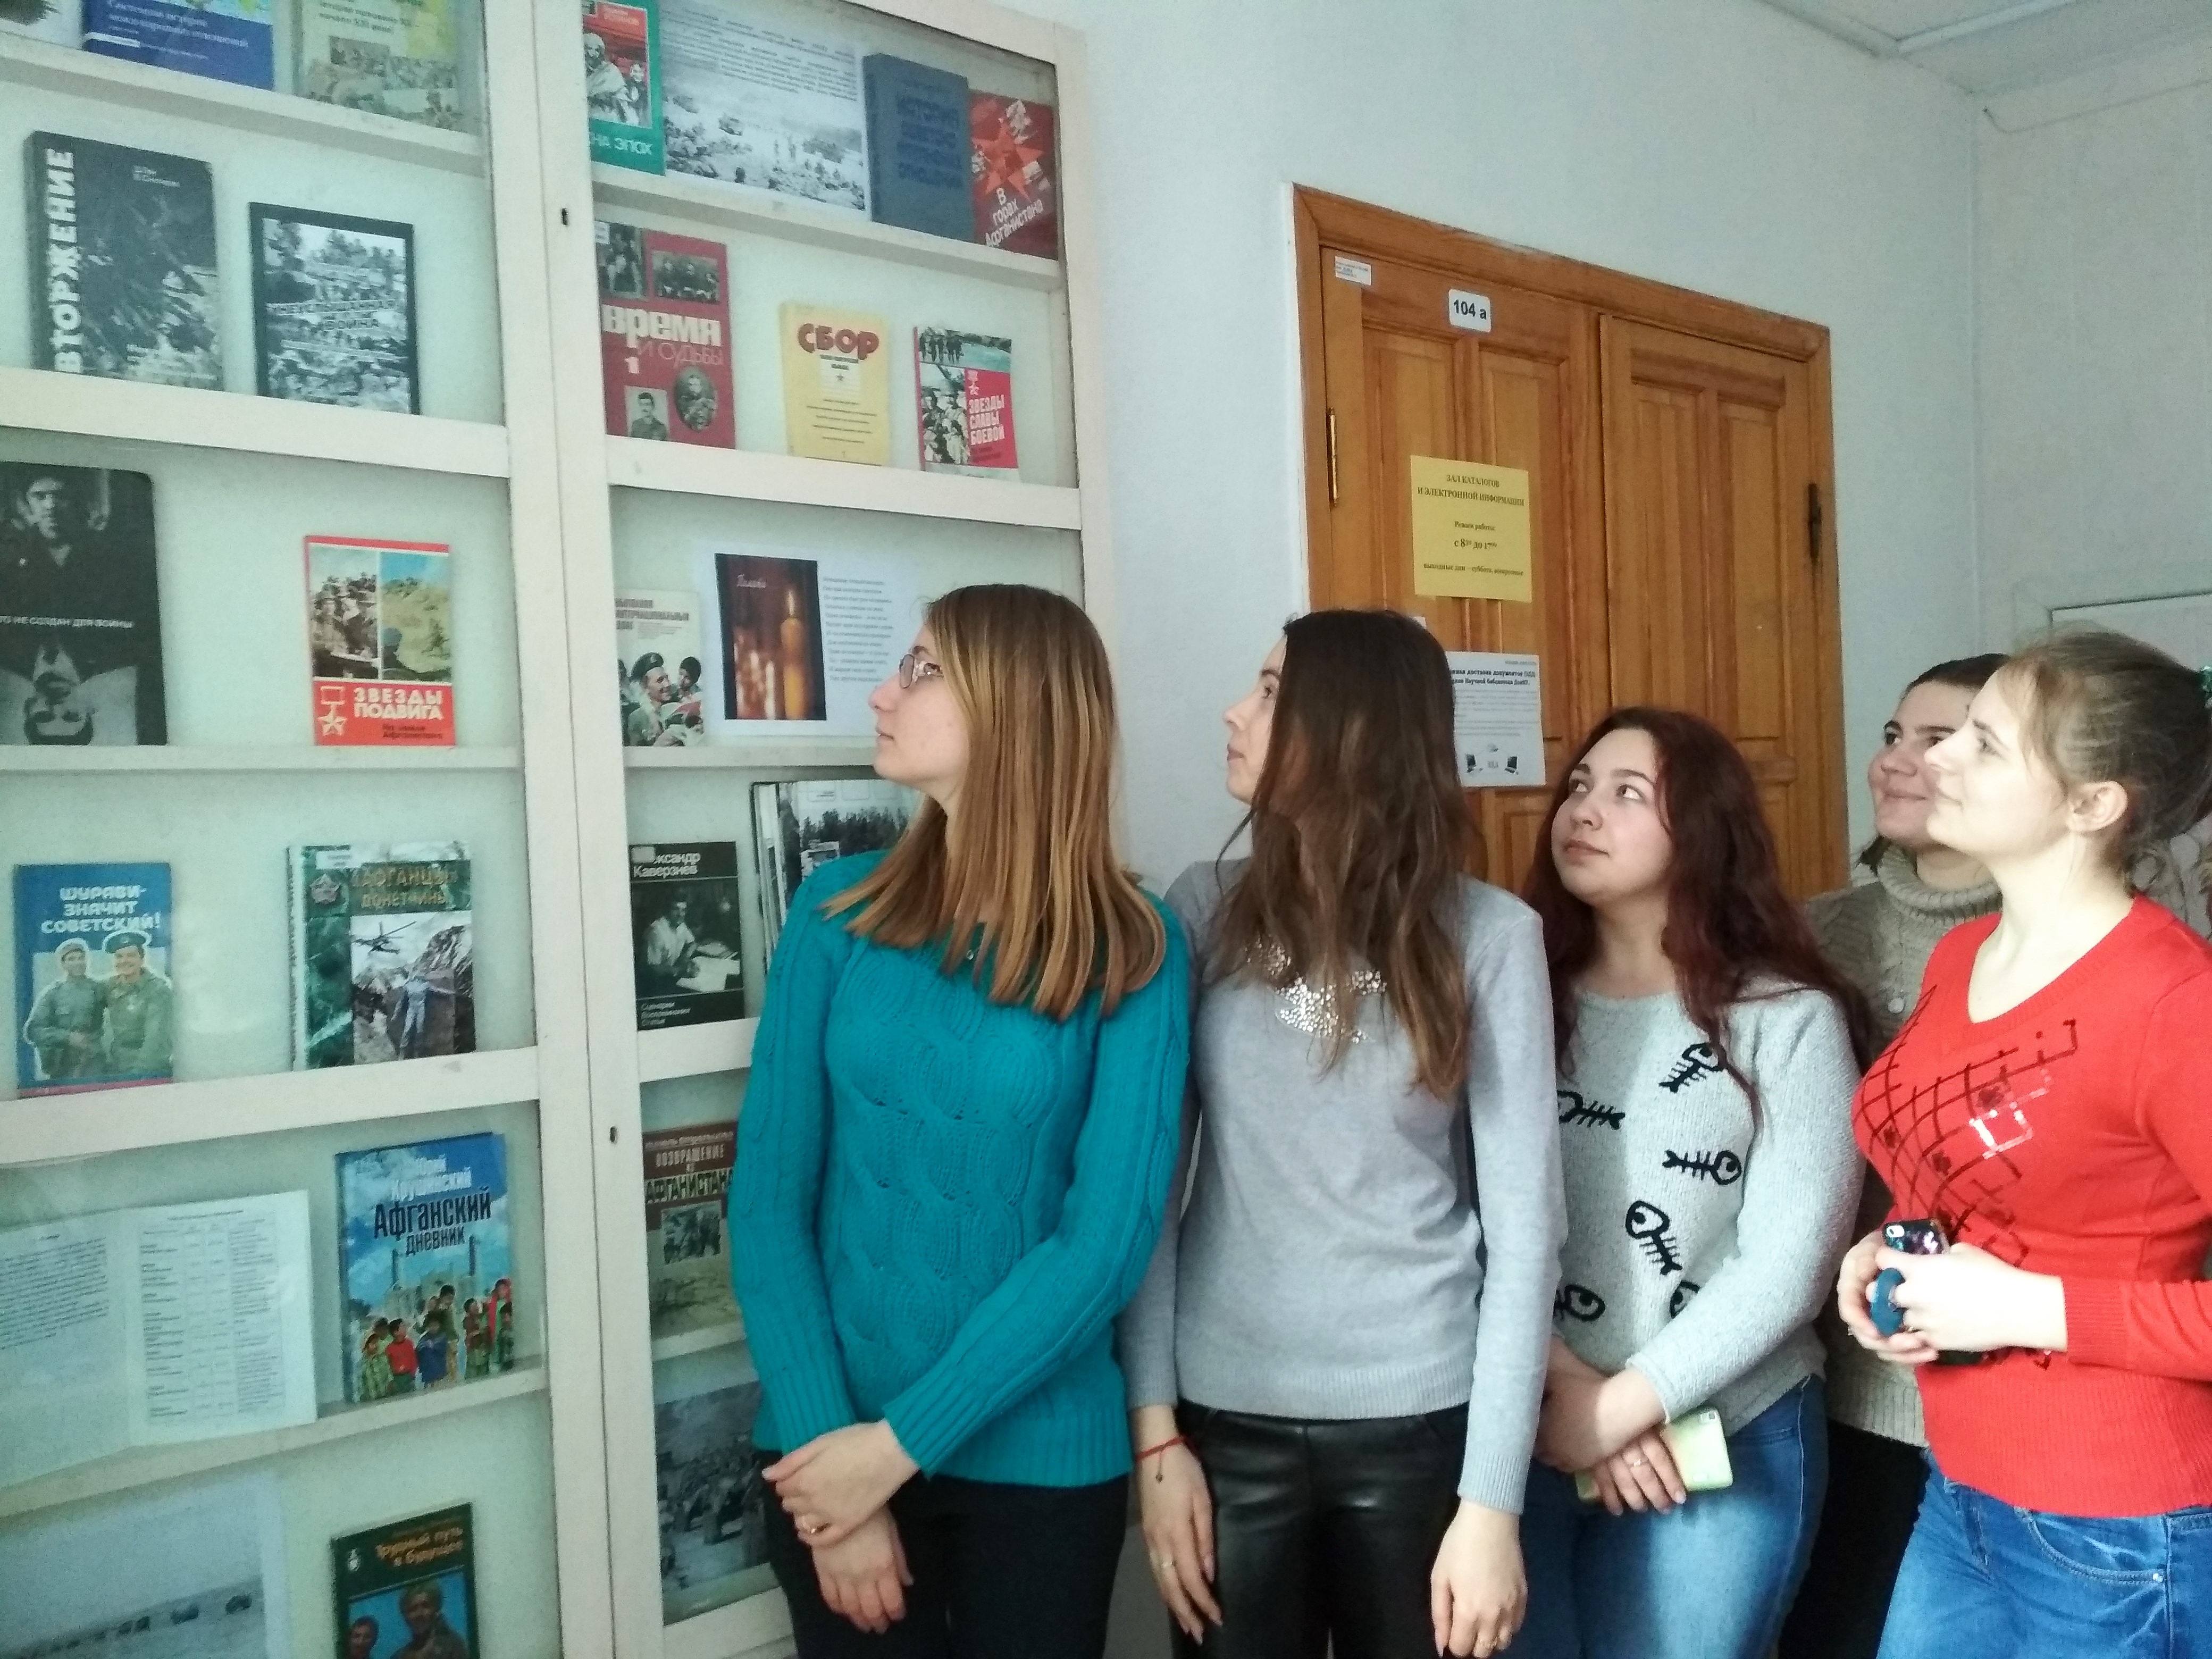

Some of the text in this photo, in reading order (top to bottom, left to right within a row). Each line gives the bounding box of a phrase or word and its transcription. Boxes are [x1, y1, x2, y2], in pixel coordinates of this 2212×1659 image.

[46, 148, 84, 373] ВТОРЖЕНИЕ
[1453, 299, 1487, 320] 104 а
[798, 323, 879, 361] СБОР
[968, 394, 1005, 414] ЗВЕЗДЫ
[969, 410, 999, 430] СЛАВЫ
[970, 424, 1005, 446] БОЕВОЙ
[1446, 474, 1499, 488] ЗАЛ КАТАЛОГОВ
[1425, 487, 1478, 500] ЭЛЕКТРОННОЙ
[1480, 493, 1524, 506] ИНФОРМАЦИИ
[353, 687, 443, 705] ЗВЕЗДЫ
[354, 702, 443, 720] ПОДВИГА
[633, 865, 698, 879] Каверзнев
[63, 900, 138, 917] ЗНАЧИТ
[40, 911, 161, 934] СОВЕТСКИЙ!
[373, 1185, 491, 1242] Афганский
